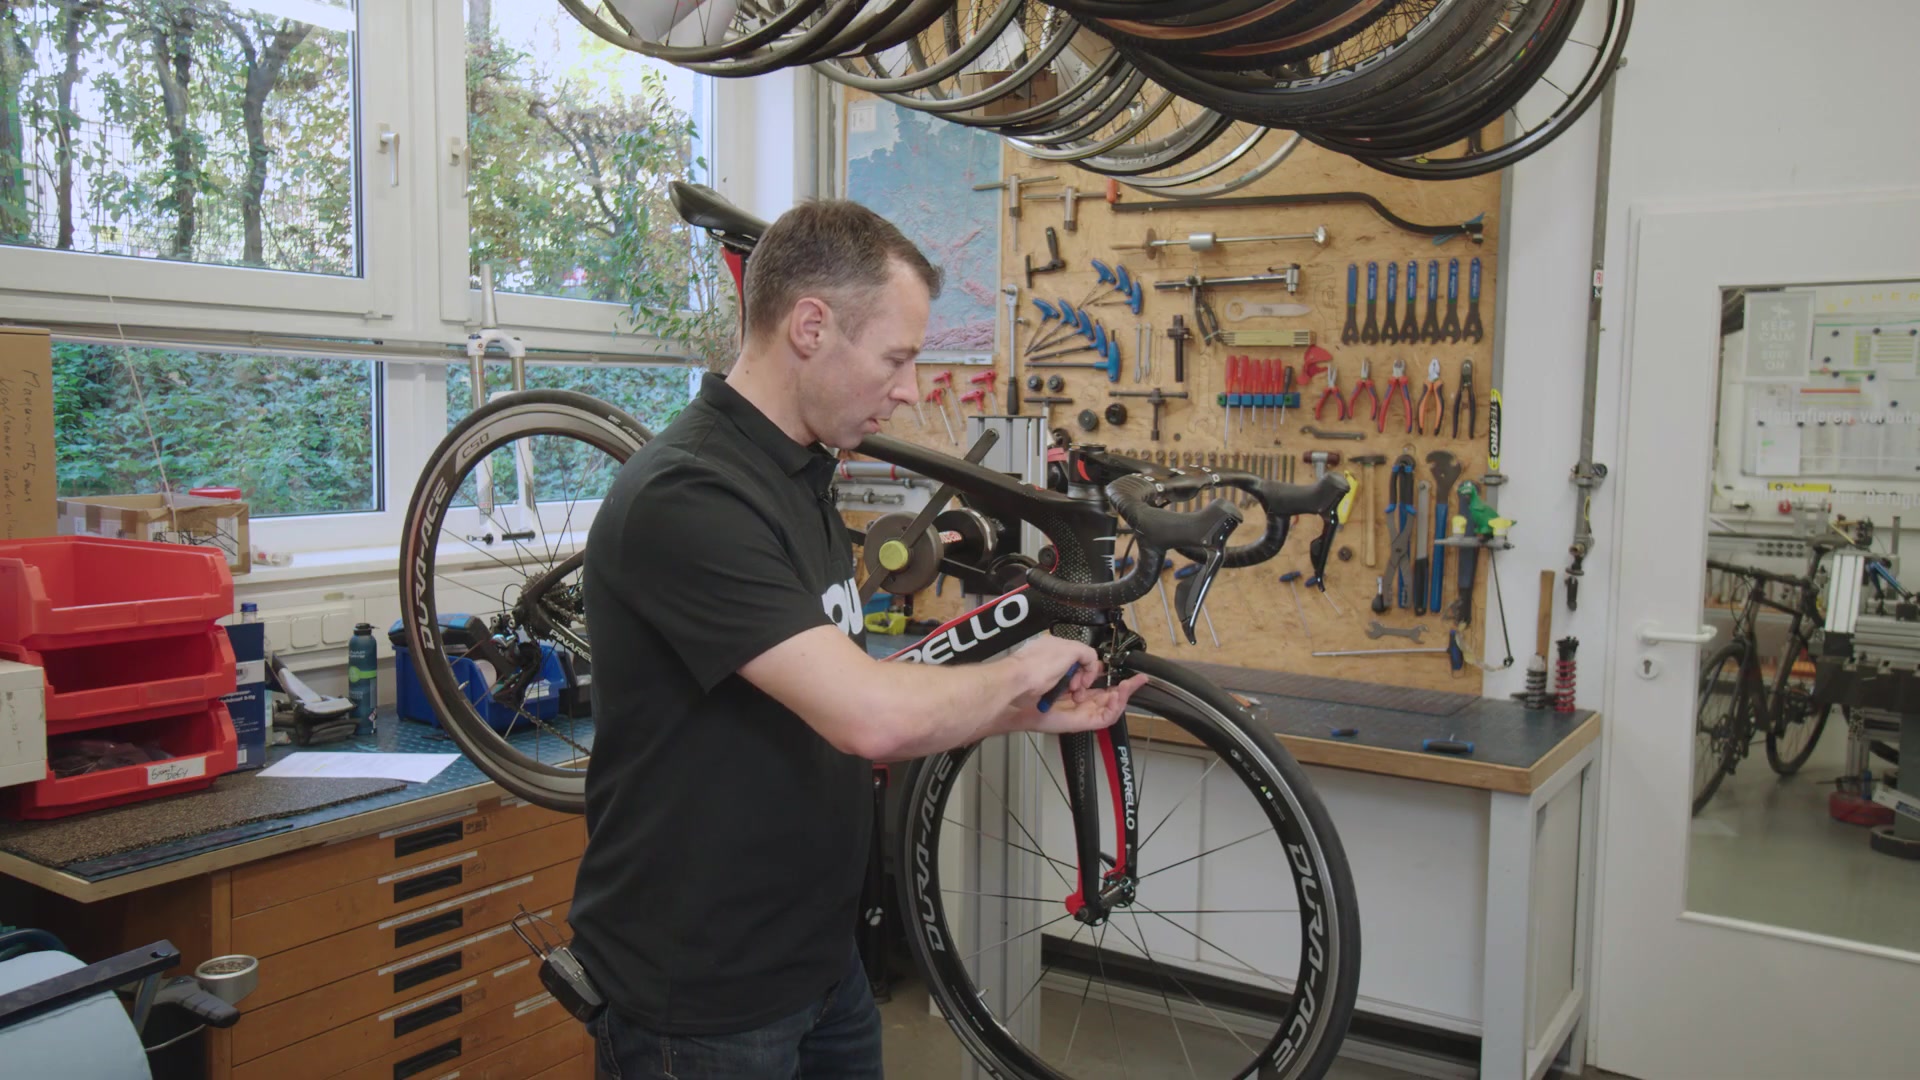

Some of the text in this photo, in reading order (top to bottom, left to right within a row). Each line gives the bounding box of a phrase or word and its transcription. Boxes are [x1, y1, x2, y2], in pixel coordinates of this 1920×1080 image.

[1490, 403, 1499, 456] TEKTRO
[415, 476, 448, 650] DURA-ACE
[549, 629, 592, 664] PINARE
[916, 752, 953, 952] DURA-ACE
[1118, 745, 1135, 831] PINARELLO
[1272, 843, 1324, 1073] DURA-ACE
